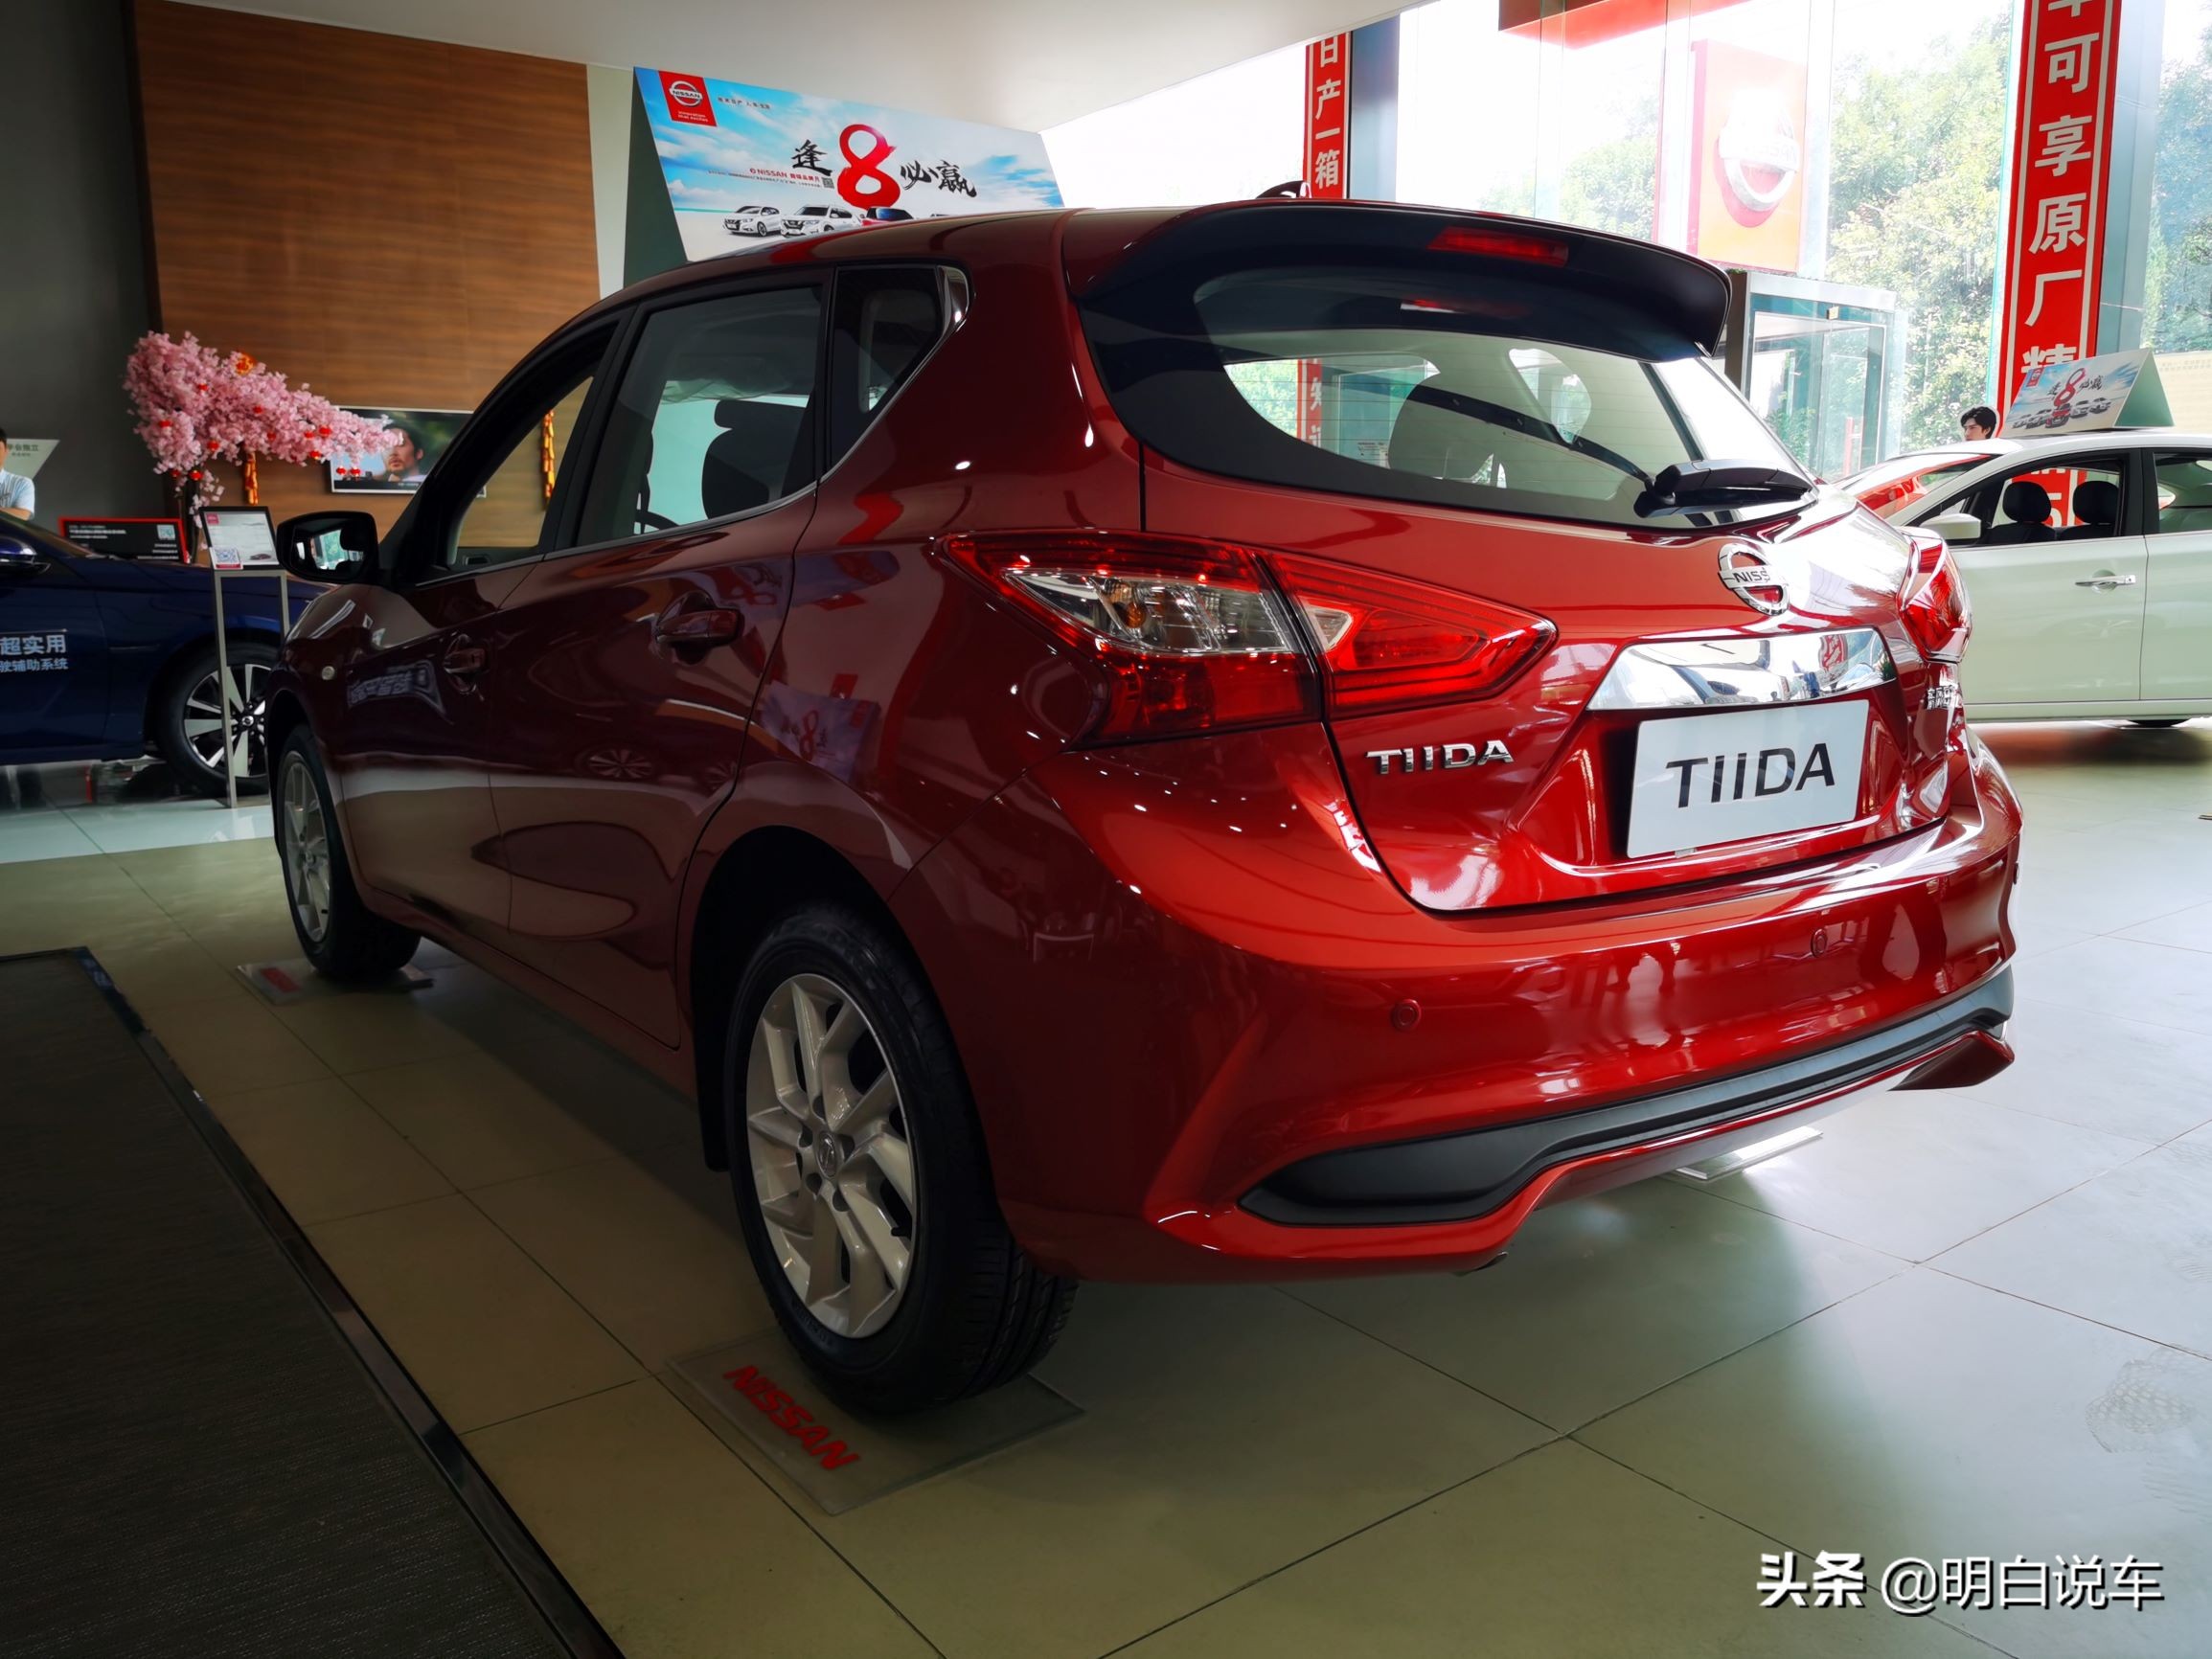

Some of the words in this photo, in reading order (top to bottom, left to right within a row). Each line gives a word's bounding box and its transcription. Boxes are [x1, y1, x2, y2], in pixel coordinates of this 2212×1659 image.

[1315, 36, 1341, 190] 日产一箱
[757, 169, 787, 178] NISSAN
[2020, 0, 2100, 375] 可享原厂
[1366, 739, 1514, 775] TIIDA
[1666, 742, 1836, 808] TIIDA
[723, 1364, 860, 1470] NISSAN
